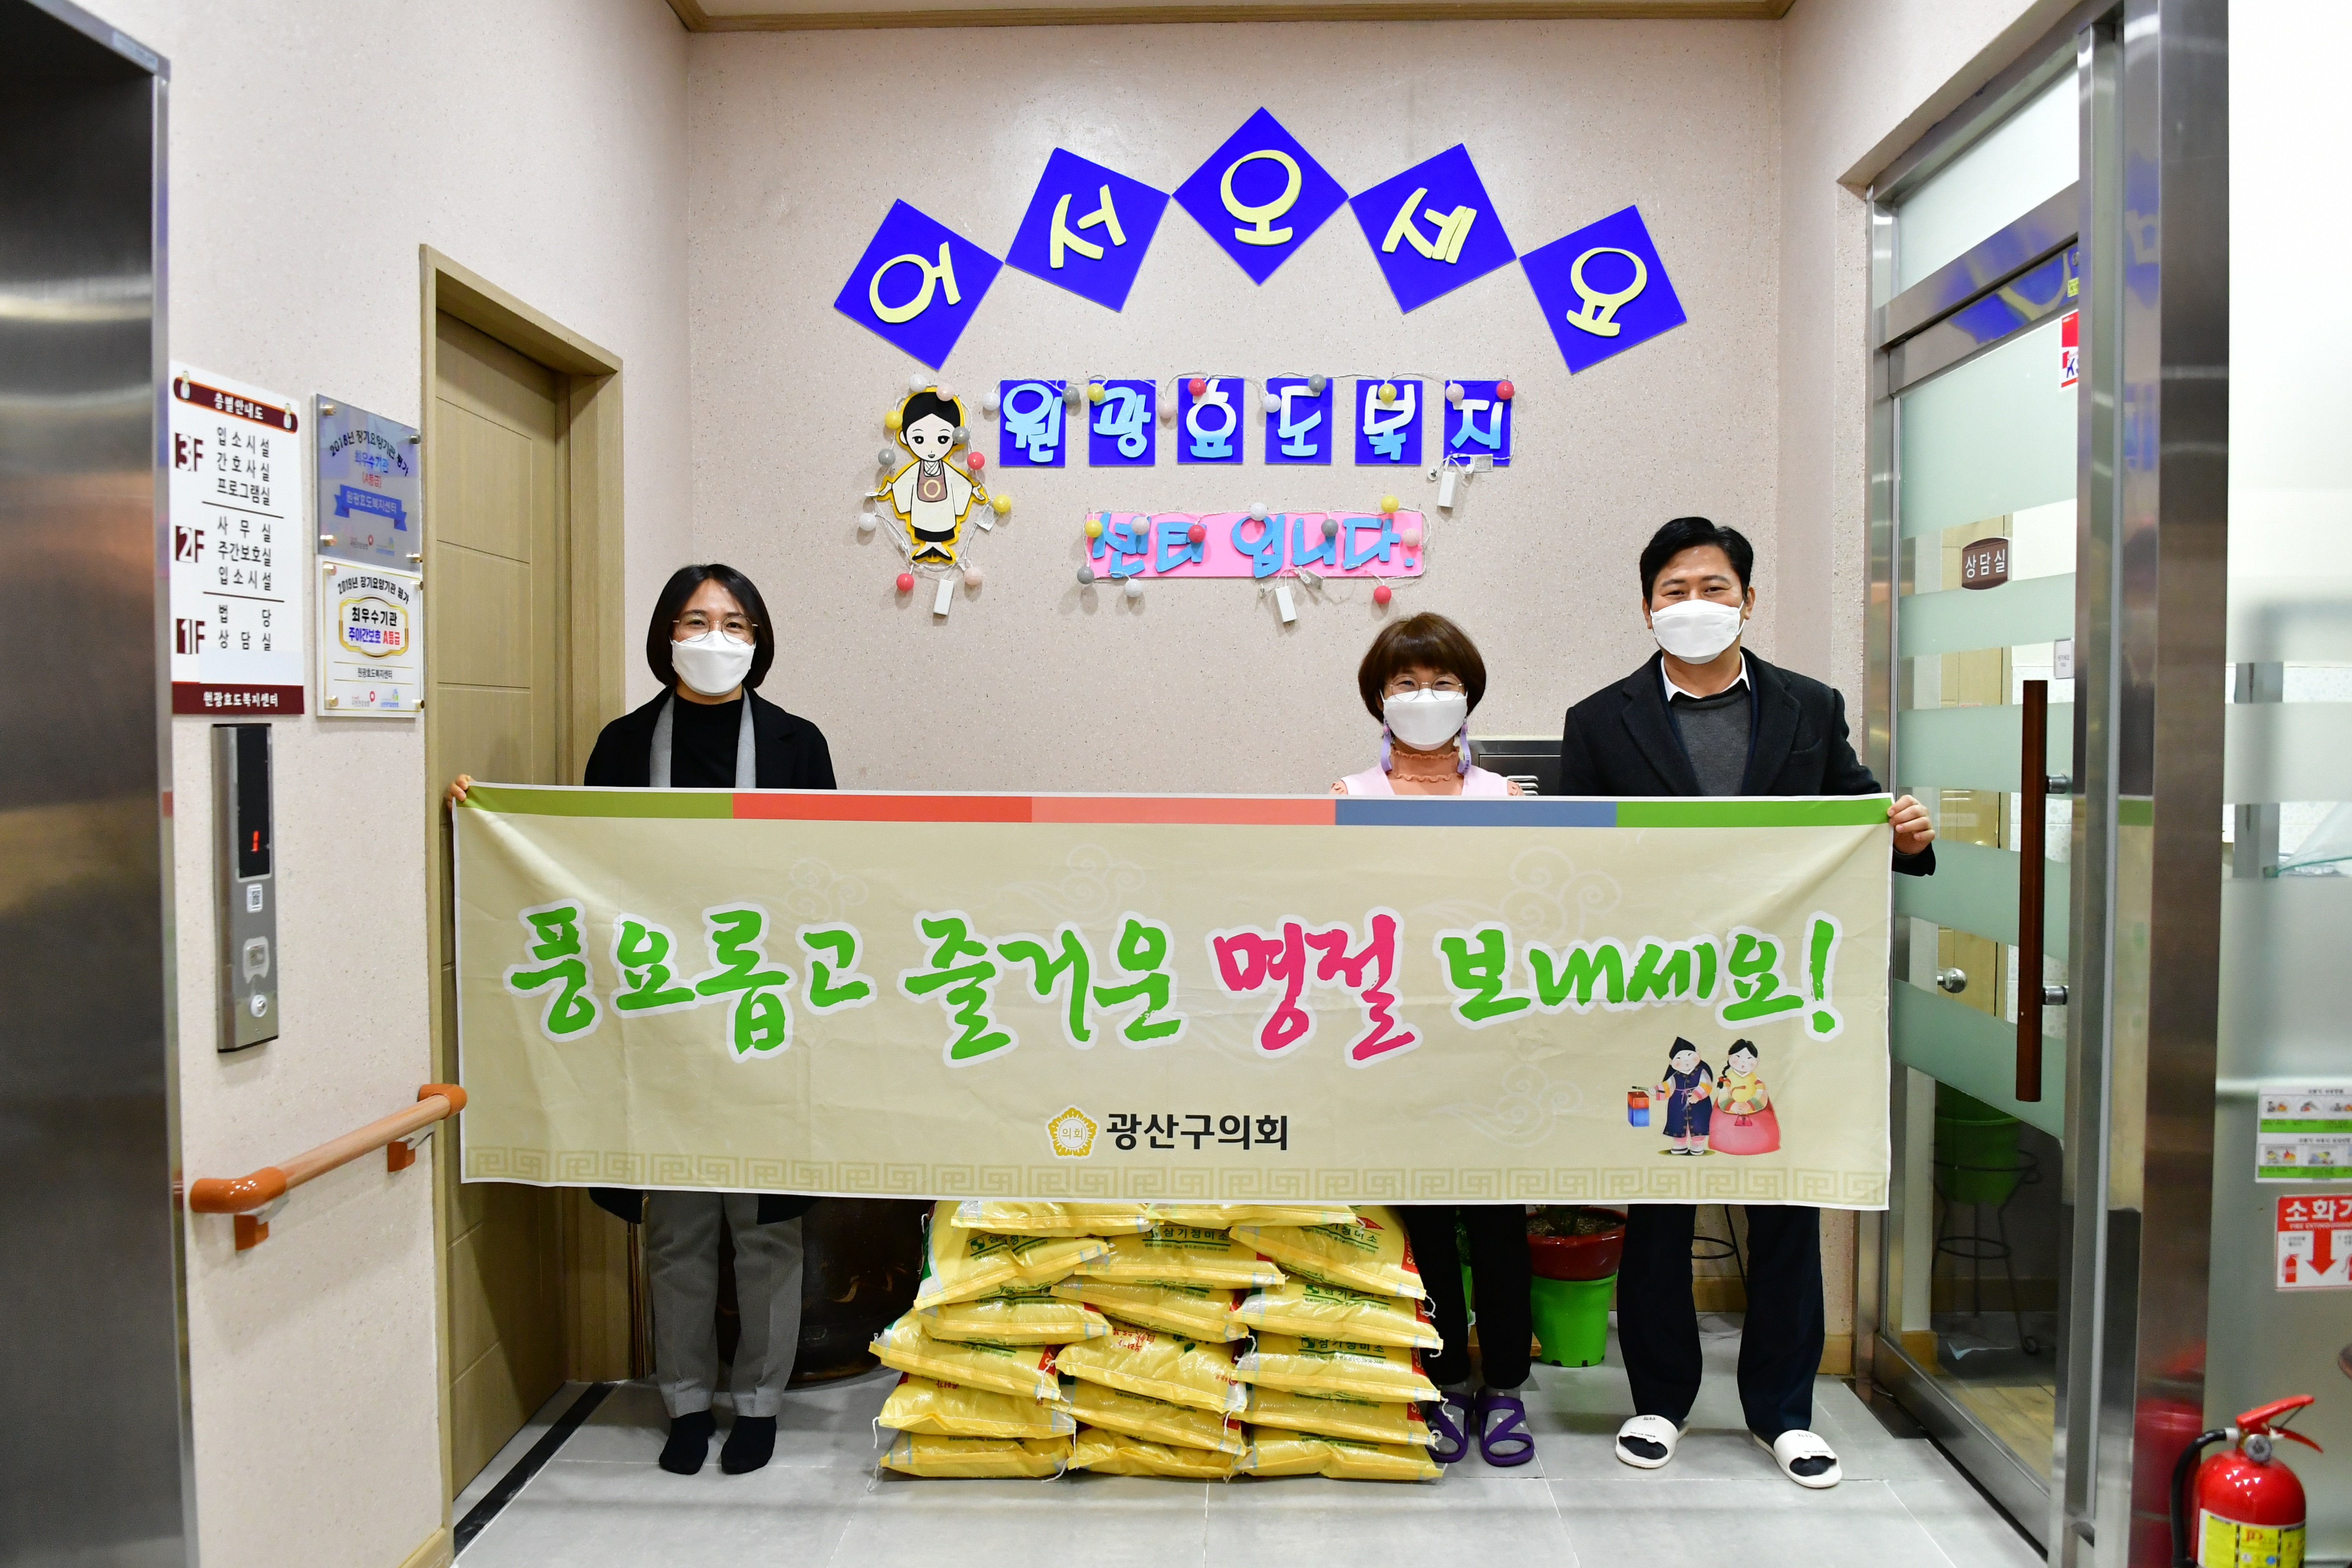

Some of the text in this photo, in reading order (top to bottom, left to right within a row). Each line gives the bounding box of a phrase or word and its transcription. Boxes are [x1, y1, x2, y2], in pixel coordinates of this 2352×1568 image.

[871, 151, 1645, 336] 어서오세요
[214, 392, 264, 420] 층별안내도
[174, 432, 204, 472] 3F
[217, 427, 270, 458] 입소시설
[217, 452, 270, 482] 간호사실
[355, 450, 389, 474] 최우수기관
[217, 478, 270, 506] 프로그램실
[346, 490, 397, 514] 원광효도복지센터
[218, 516, 271, 543] 사무실
[175, 525, 205, 564] 2F
[218, 541, 272, 567] 주간보호실
[1092, 512, 1206, 578] 센터
[1965, 549, 2006, 578] 상담실
[218, 566, 272, 591] 입소시설
[338, 576, 409, 604] 2019년 장기요양기관 평가
[352, 607, 397, 626] 최우수기관
[176, 618, 206, 655] 1F
[218, 630, 272, 651] 상담실
[383, 631, 400, 645] A등급
[203, 691, 278, 708] 원광효도복지센터
[511, 906, 1836, 1061] 풍요롭고 즐거운 명절 보내세요!
[1062, 1127, 1084, 1141] 의회
[1106, 1113, 1288, 1151] 광산구의회
[1163, 1227, 1229, 1241] 삼기정미소
